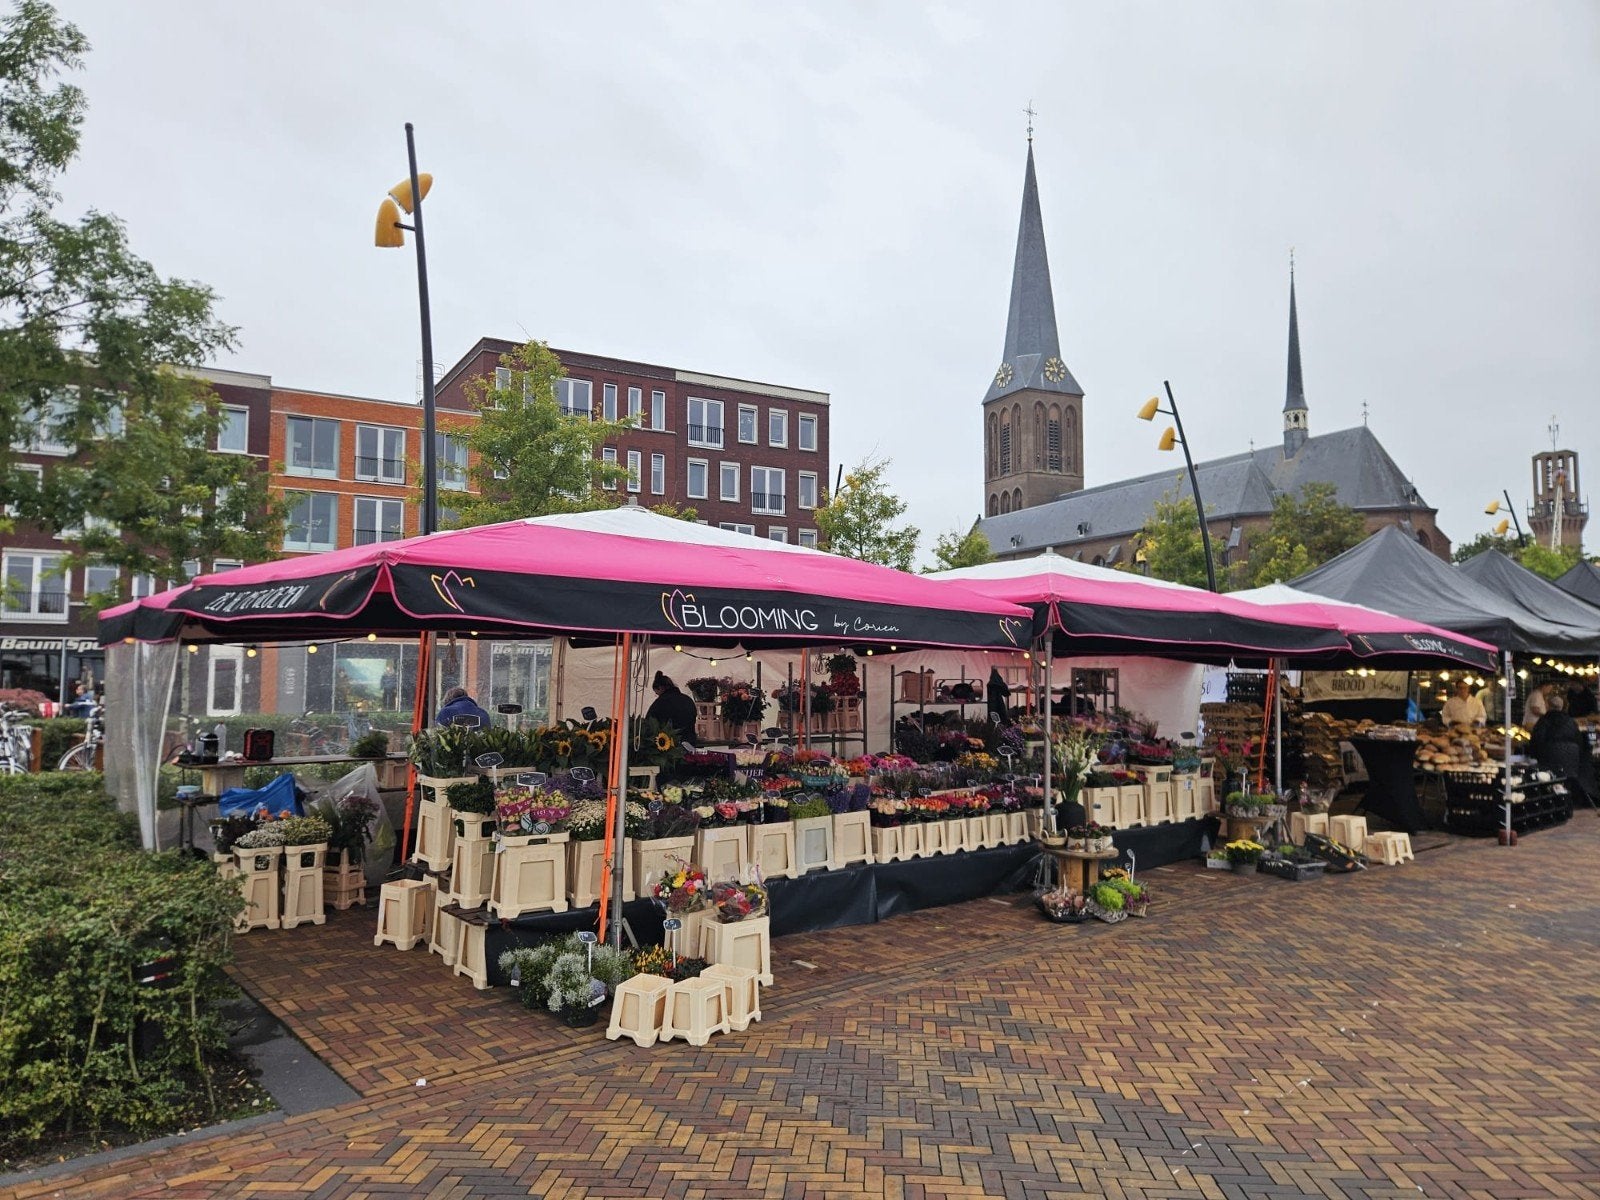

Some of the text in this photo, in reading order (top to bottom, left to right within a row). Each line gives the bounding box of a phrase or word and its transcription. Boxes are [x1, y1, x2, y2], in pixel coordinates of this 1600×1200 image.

[682, 604, 819, 631] BLOOMING
[833, 614, 849, 635] by
[0, 638, 62, 650] Baum
[1331, 679, 1366, 692] BROOD
